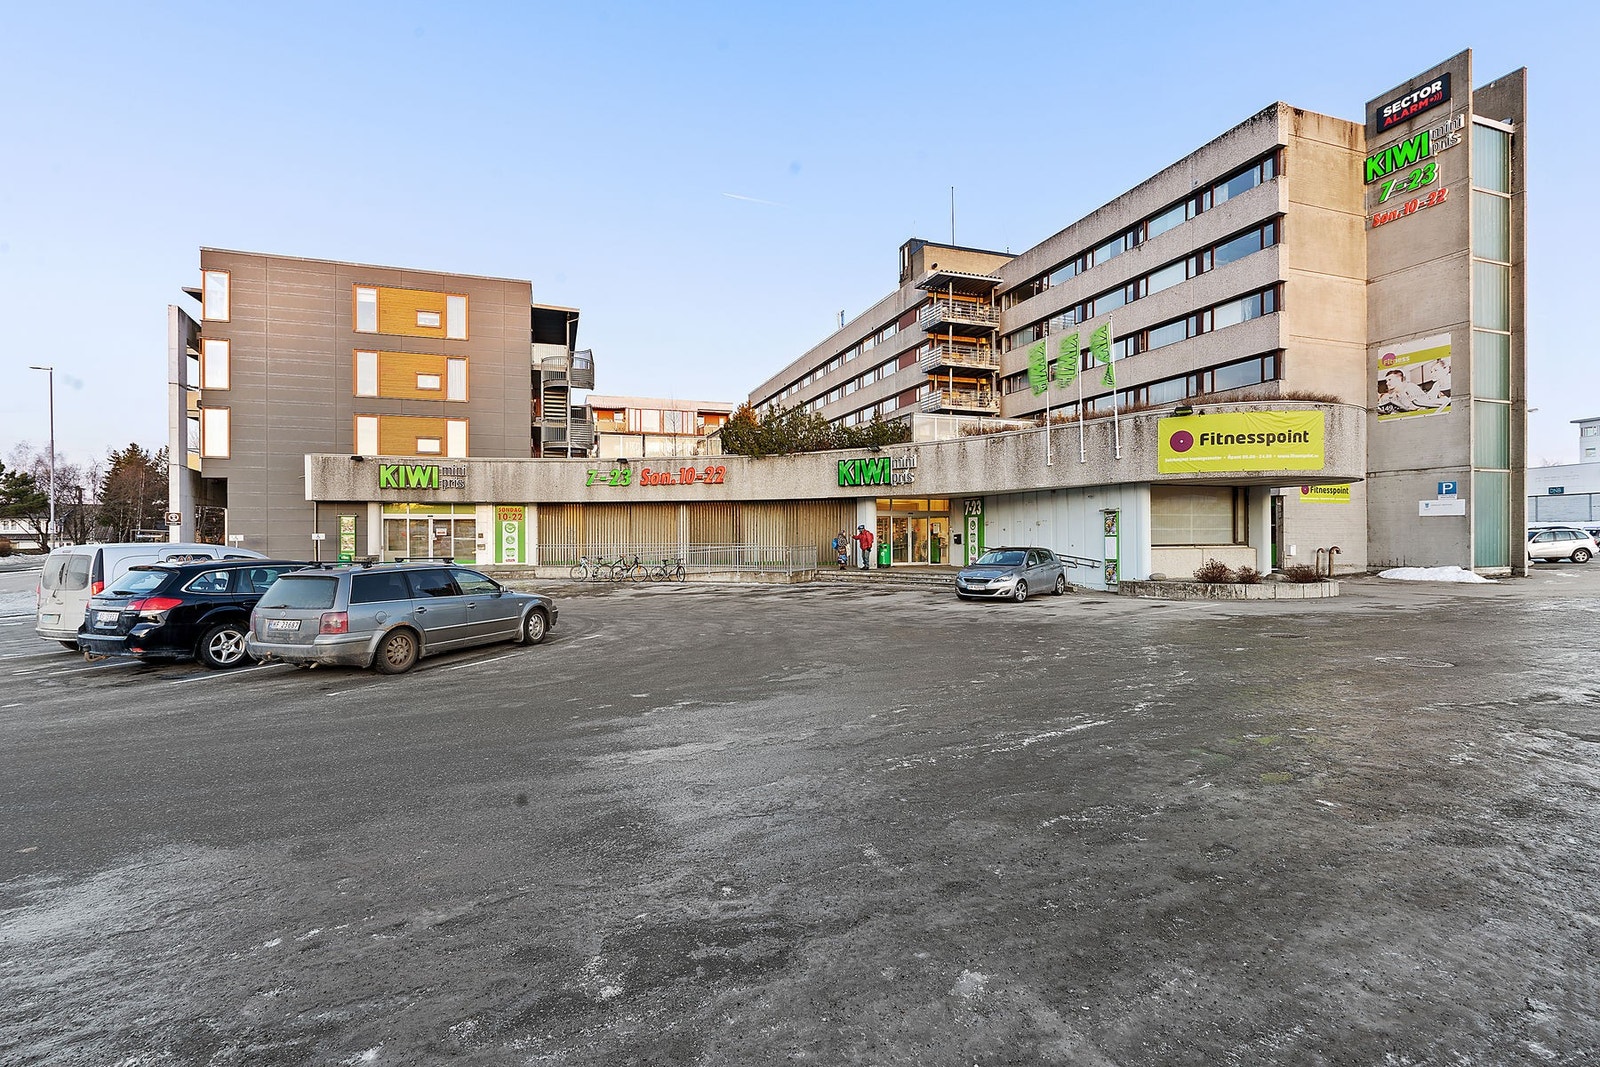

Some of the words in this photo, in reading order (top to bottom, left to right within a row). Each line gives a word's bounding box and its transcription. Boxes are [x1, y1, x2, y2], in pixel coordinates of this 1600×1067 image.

[1383, 80, 1442, 117] SECTOR
[1384, 98, 1429, 127] ALARM
[1432, 114, 1464, 140] mini
[1432, 133, 1461, 155] pris
[1365, 130, 1430, 184] KIWI
[1199, 430, 1310, 447] Fitnesspoint
[441, 464, 466, 477] mini
[892, 454, 917, 469] mini
[379, 464, 440, 489] KIWI
[838, 457, 891, 486] KIWI
[892, 470, 914, 486] pris
[441, 477, 466, 491] pris
[1310, 485, 1349, 495] Fitnesspoint
[1442, 482, 1454, 494] P
